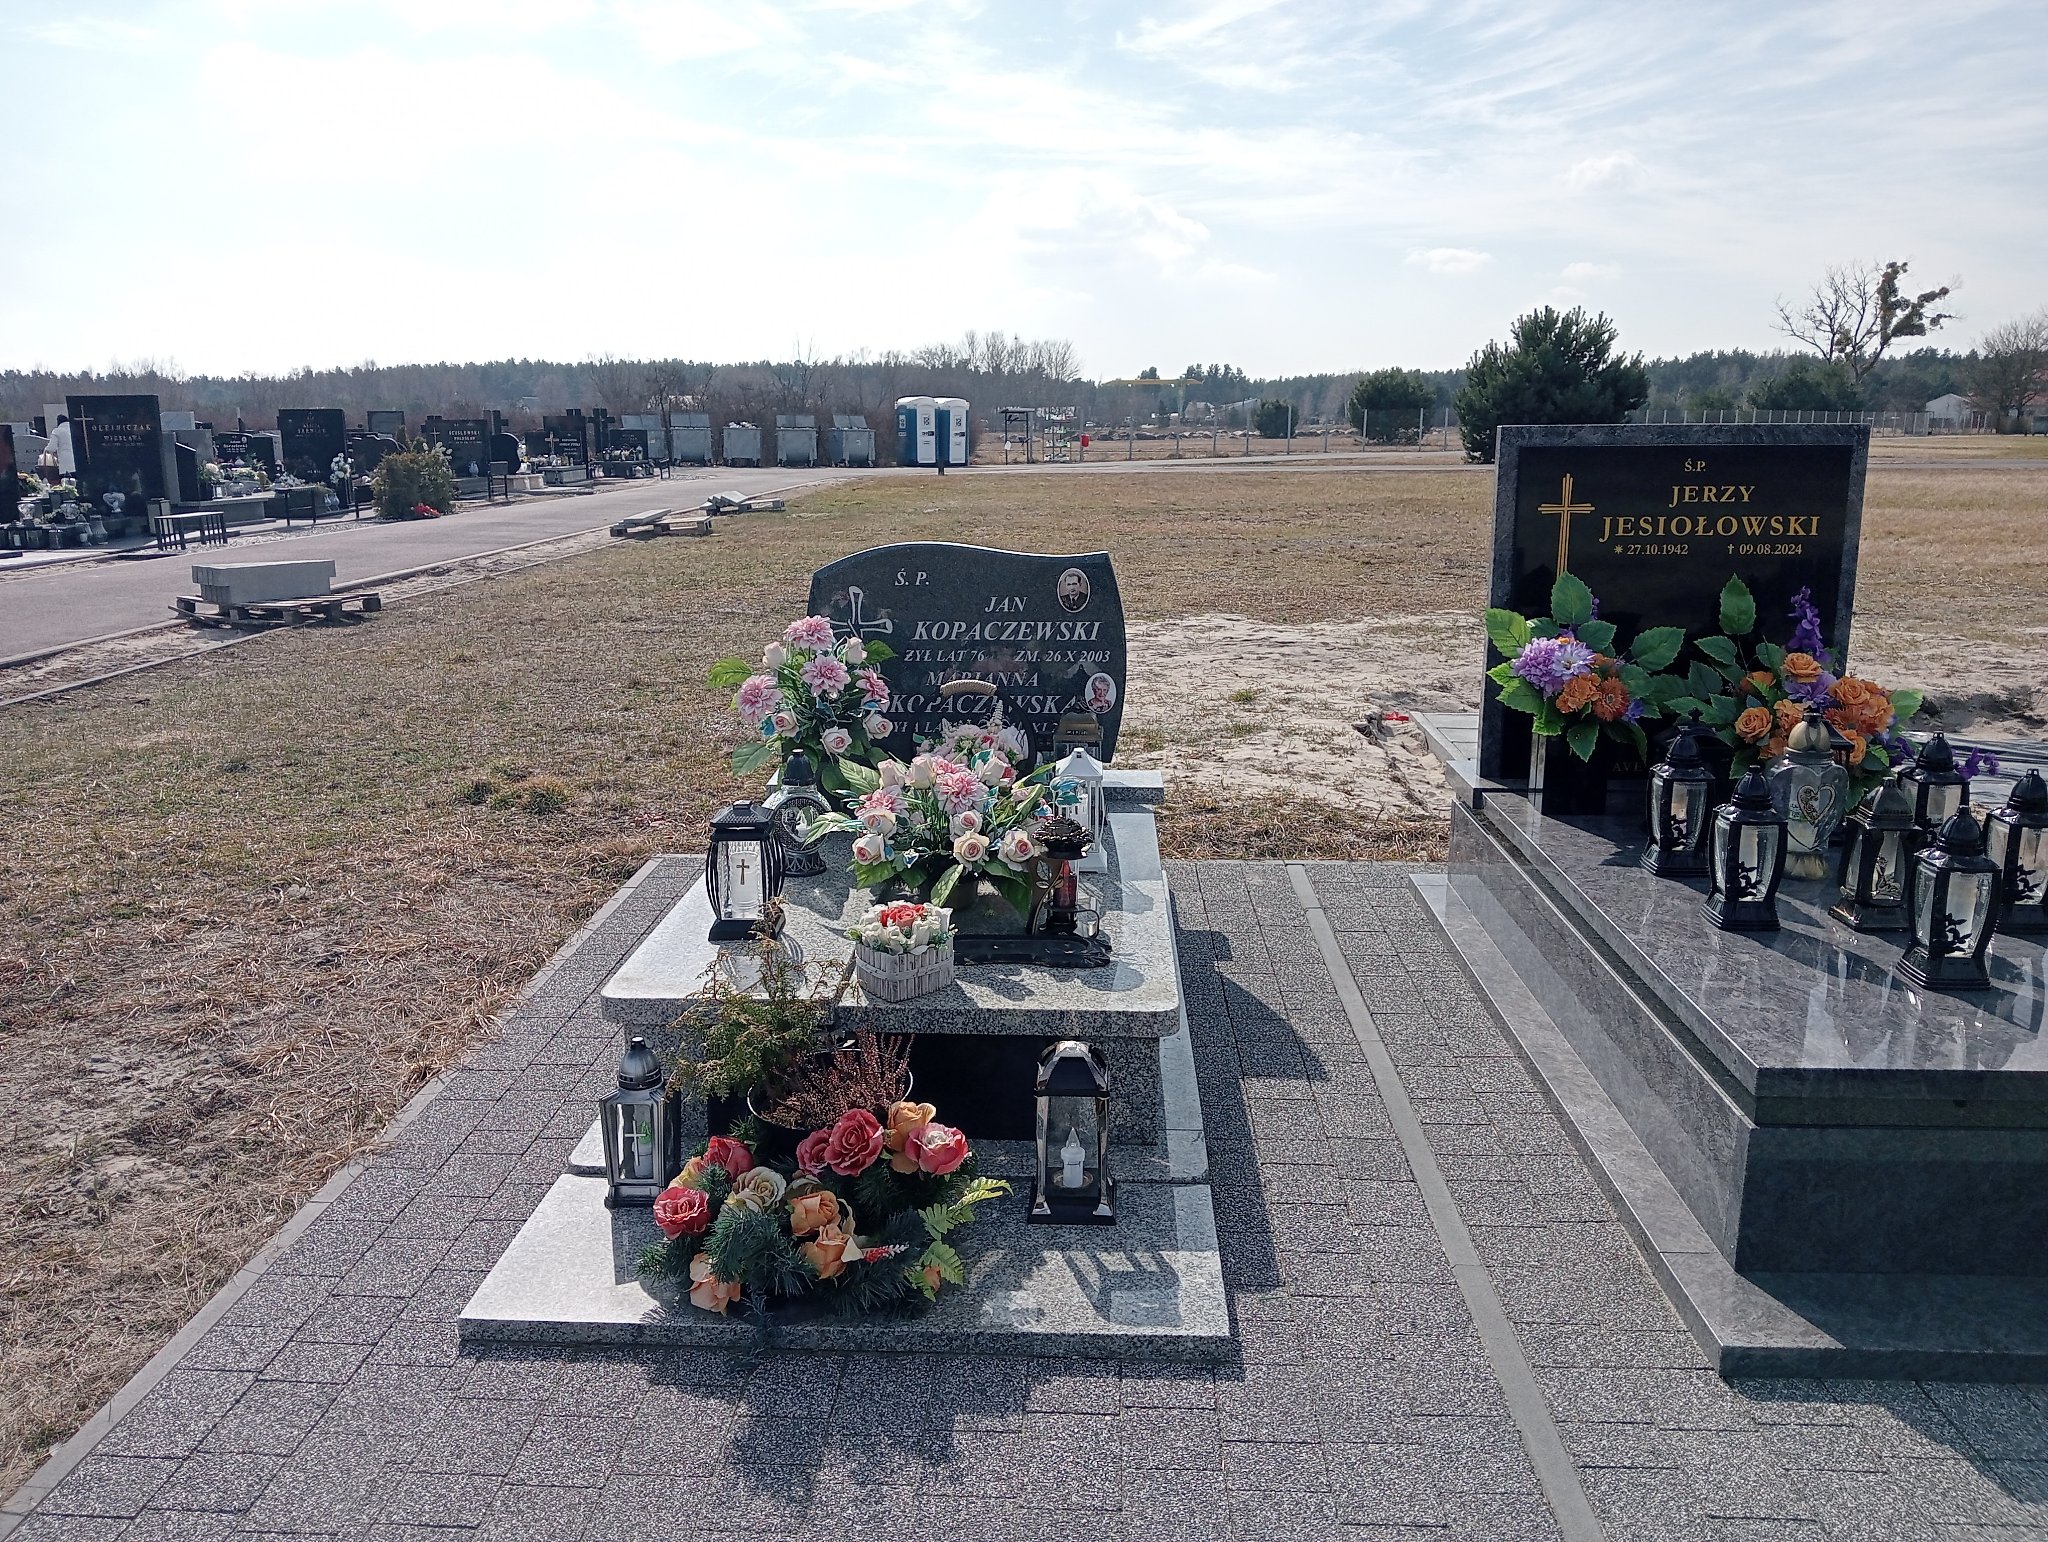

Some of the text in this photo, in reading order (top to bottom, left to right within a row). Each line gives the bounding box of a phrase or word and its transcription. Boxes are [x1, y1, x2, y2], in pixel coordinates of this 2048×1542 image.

[1684, 458, 1707, 472] Ś.P.
[1669, 485, 1756, 508] JERZY
[1599, 515, 1821, 543] JESIOŁOWSKI
[1626, 544, 1802, 556] 27.10.1942 09.08.2024
[985, 596, 1028, 613] JAN
[912, 621, 1103, 641] KOPACZEWSKI
[936, 649, 969, 662] LAT
[970, 649, 986, 662] 76
[1014, 650, 1041, 662] ZM.
[1045, 650, 1062, 662] 26
[1063, 650, 1076, 662] X
[1078, 650, 1111, 663] 2003
